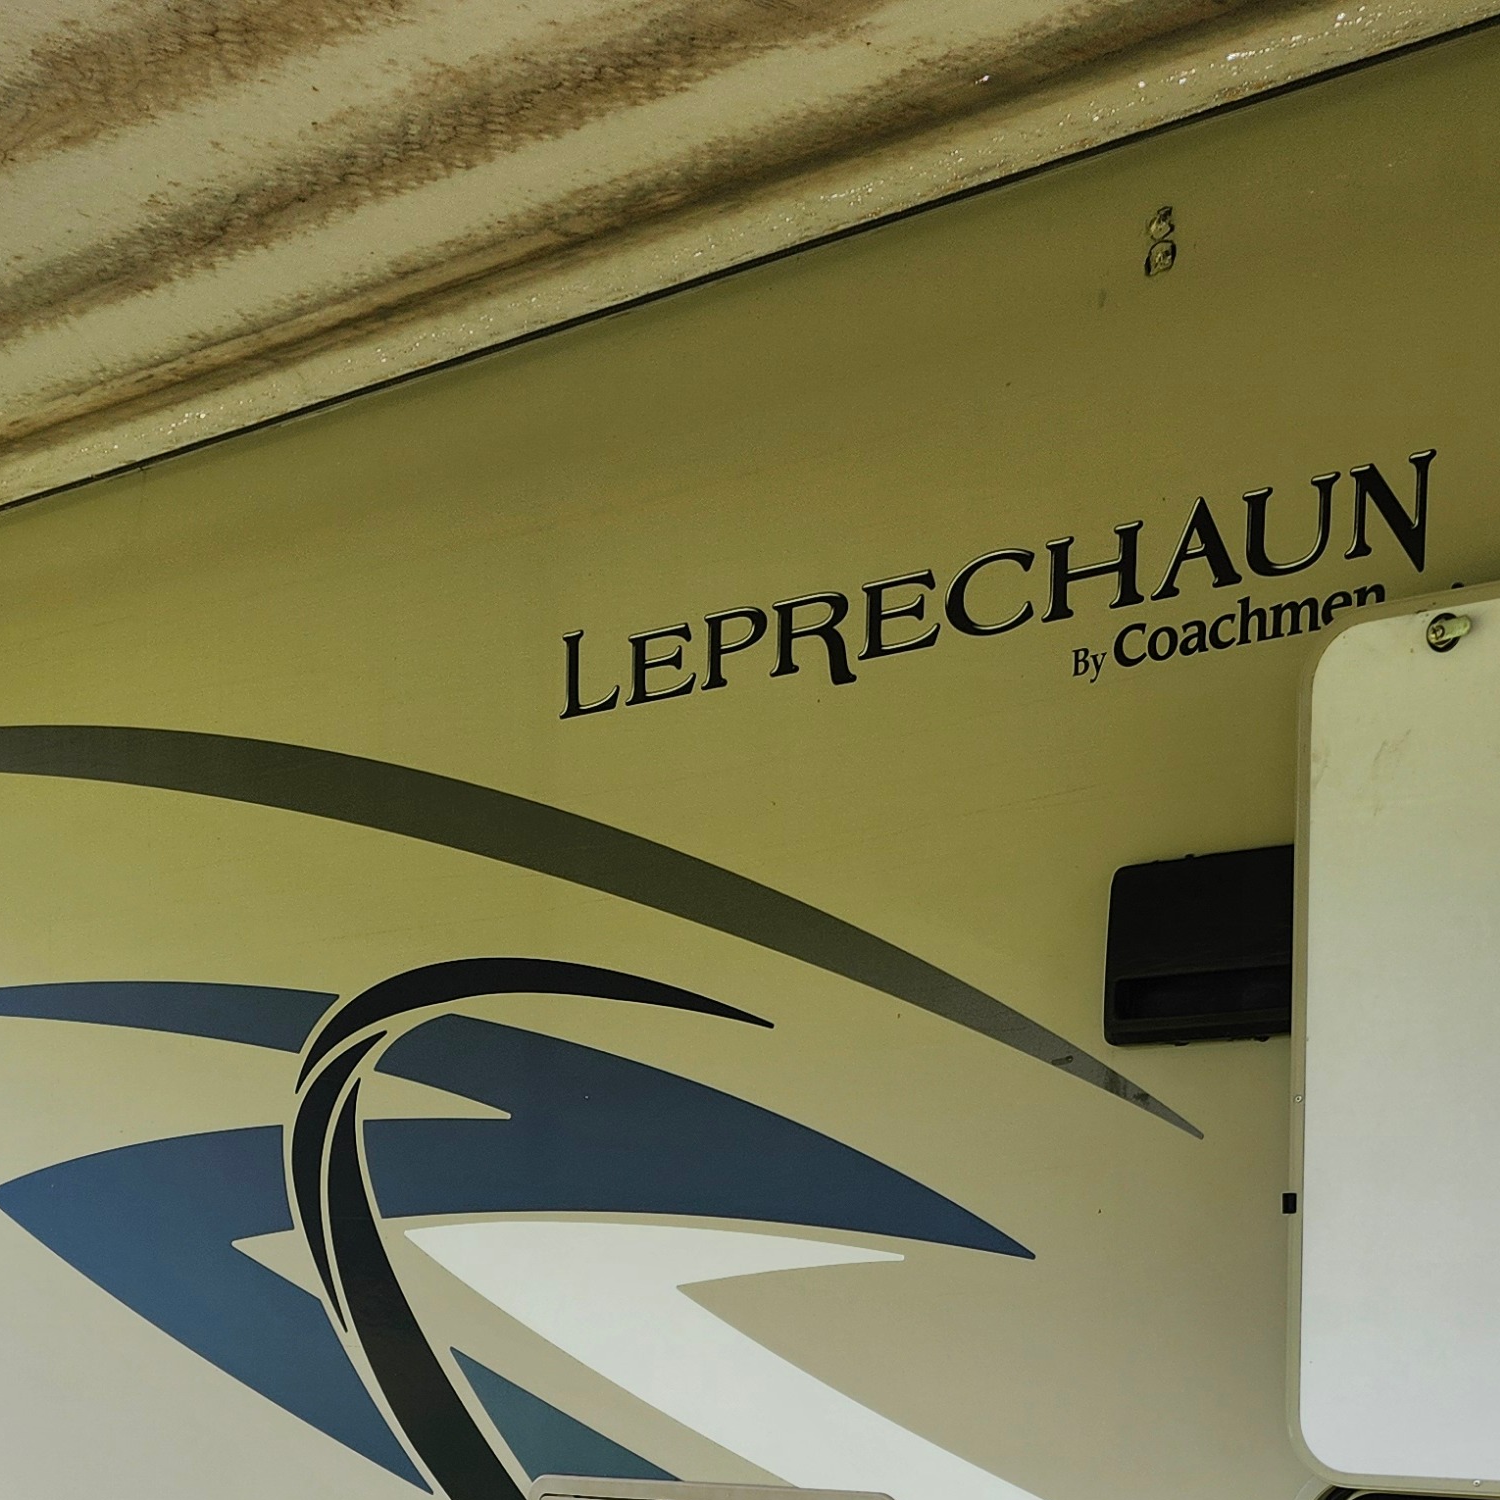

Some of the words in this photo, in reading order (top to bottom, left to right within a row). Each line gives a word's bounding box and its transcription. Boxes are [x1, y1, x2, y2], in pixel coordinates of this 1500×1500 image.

[558, 448, 1437, 720] LEPRECHAUN
[1071, 647, 1107, 683] By
[1112, 582, 1386, 666] Coachmen
